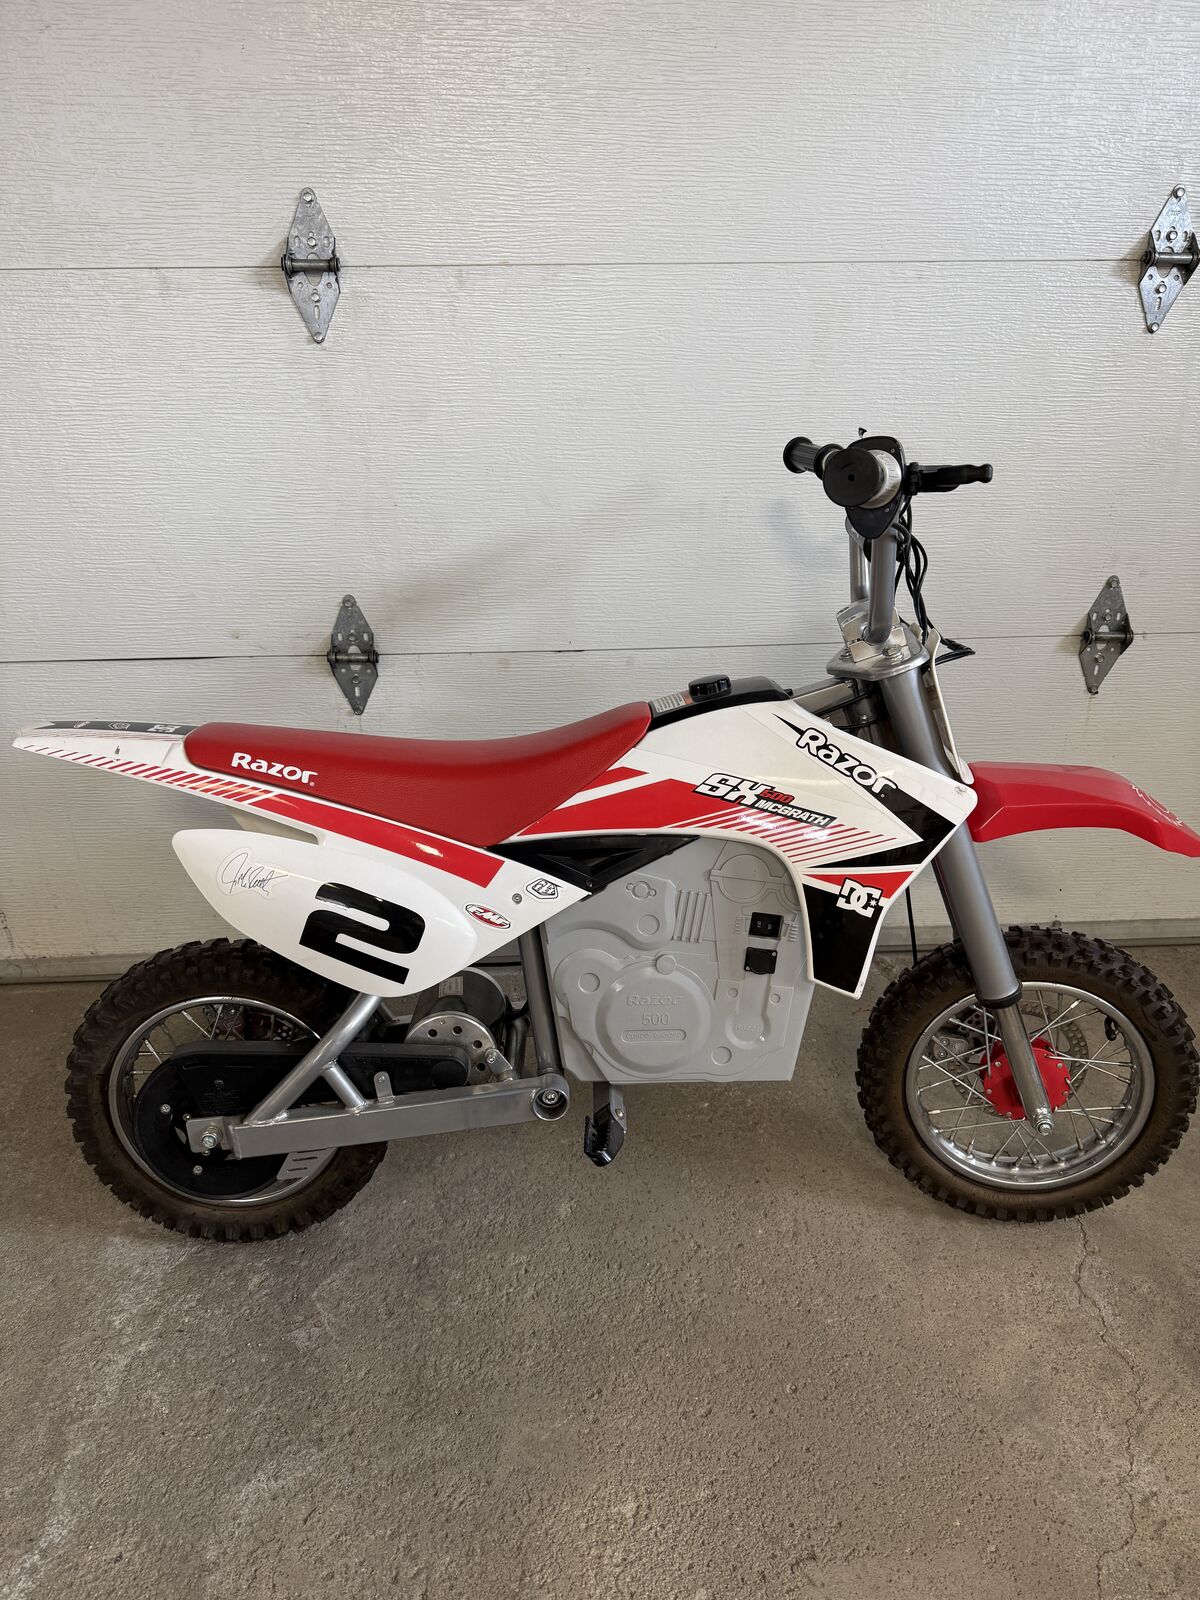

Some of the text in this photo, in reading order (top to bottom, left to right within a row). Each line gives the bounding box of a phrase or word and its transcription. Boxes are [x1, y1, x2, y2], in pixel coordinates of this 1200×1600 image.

[231, 752, 318, 784] Razor
[796, 727, 899, 794] Razor
[694, 773, 796, 806] SX 500
[755, 799, 832, 827] MCGRATH
[836, 878, 882, 918] DC
[466, 904, 511, 929] FMF
[299, 882, 425, 984] 2
[641, 1011, 671, 1026] 500
